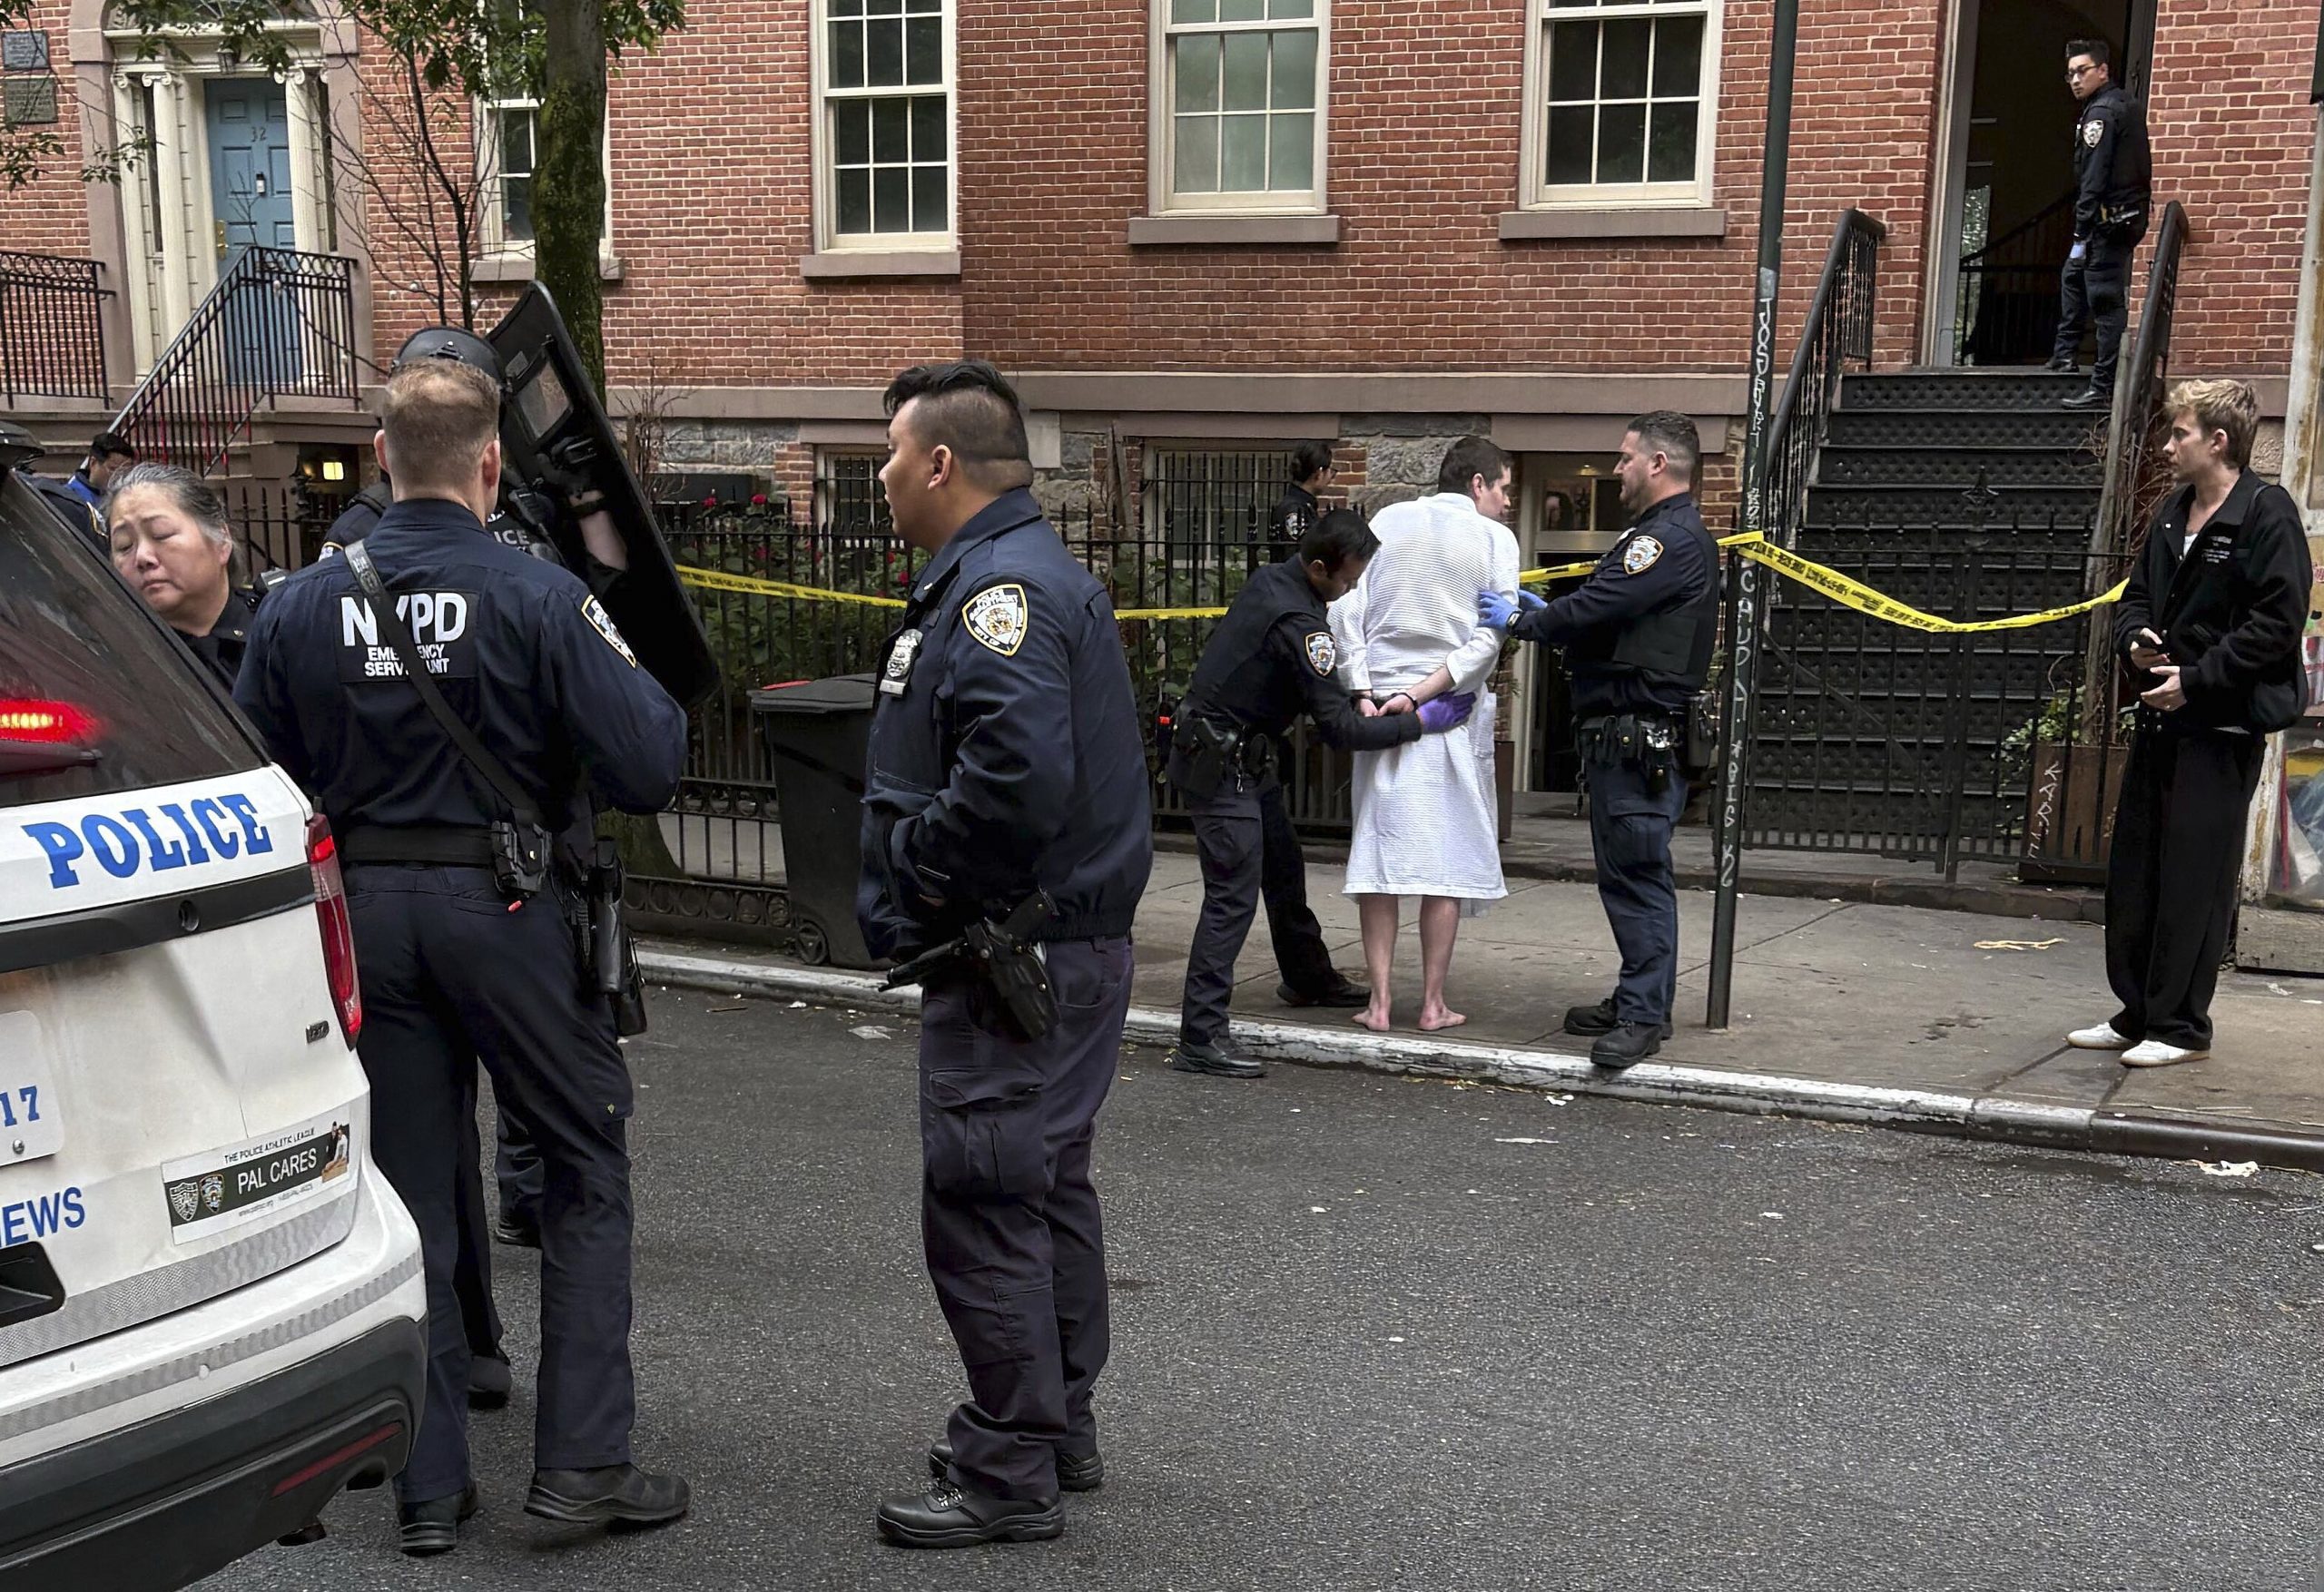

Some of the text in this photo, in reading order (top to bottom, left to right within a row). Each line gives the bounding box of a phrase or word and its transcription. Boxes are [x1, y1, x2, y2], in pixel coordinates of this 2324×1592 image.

[251, 126, 268, 142] 32
[20, 793, 273, 889] POLICE
[224, 1152, 239, 1164] THE
[240, 1145, 263, 1159] POLICE
[237, 1166, 268, 1195] PAL
[270, 1147, 318, 1184] CARES
[0, 1186, 86, 1247] EWS
